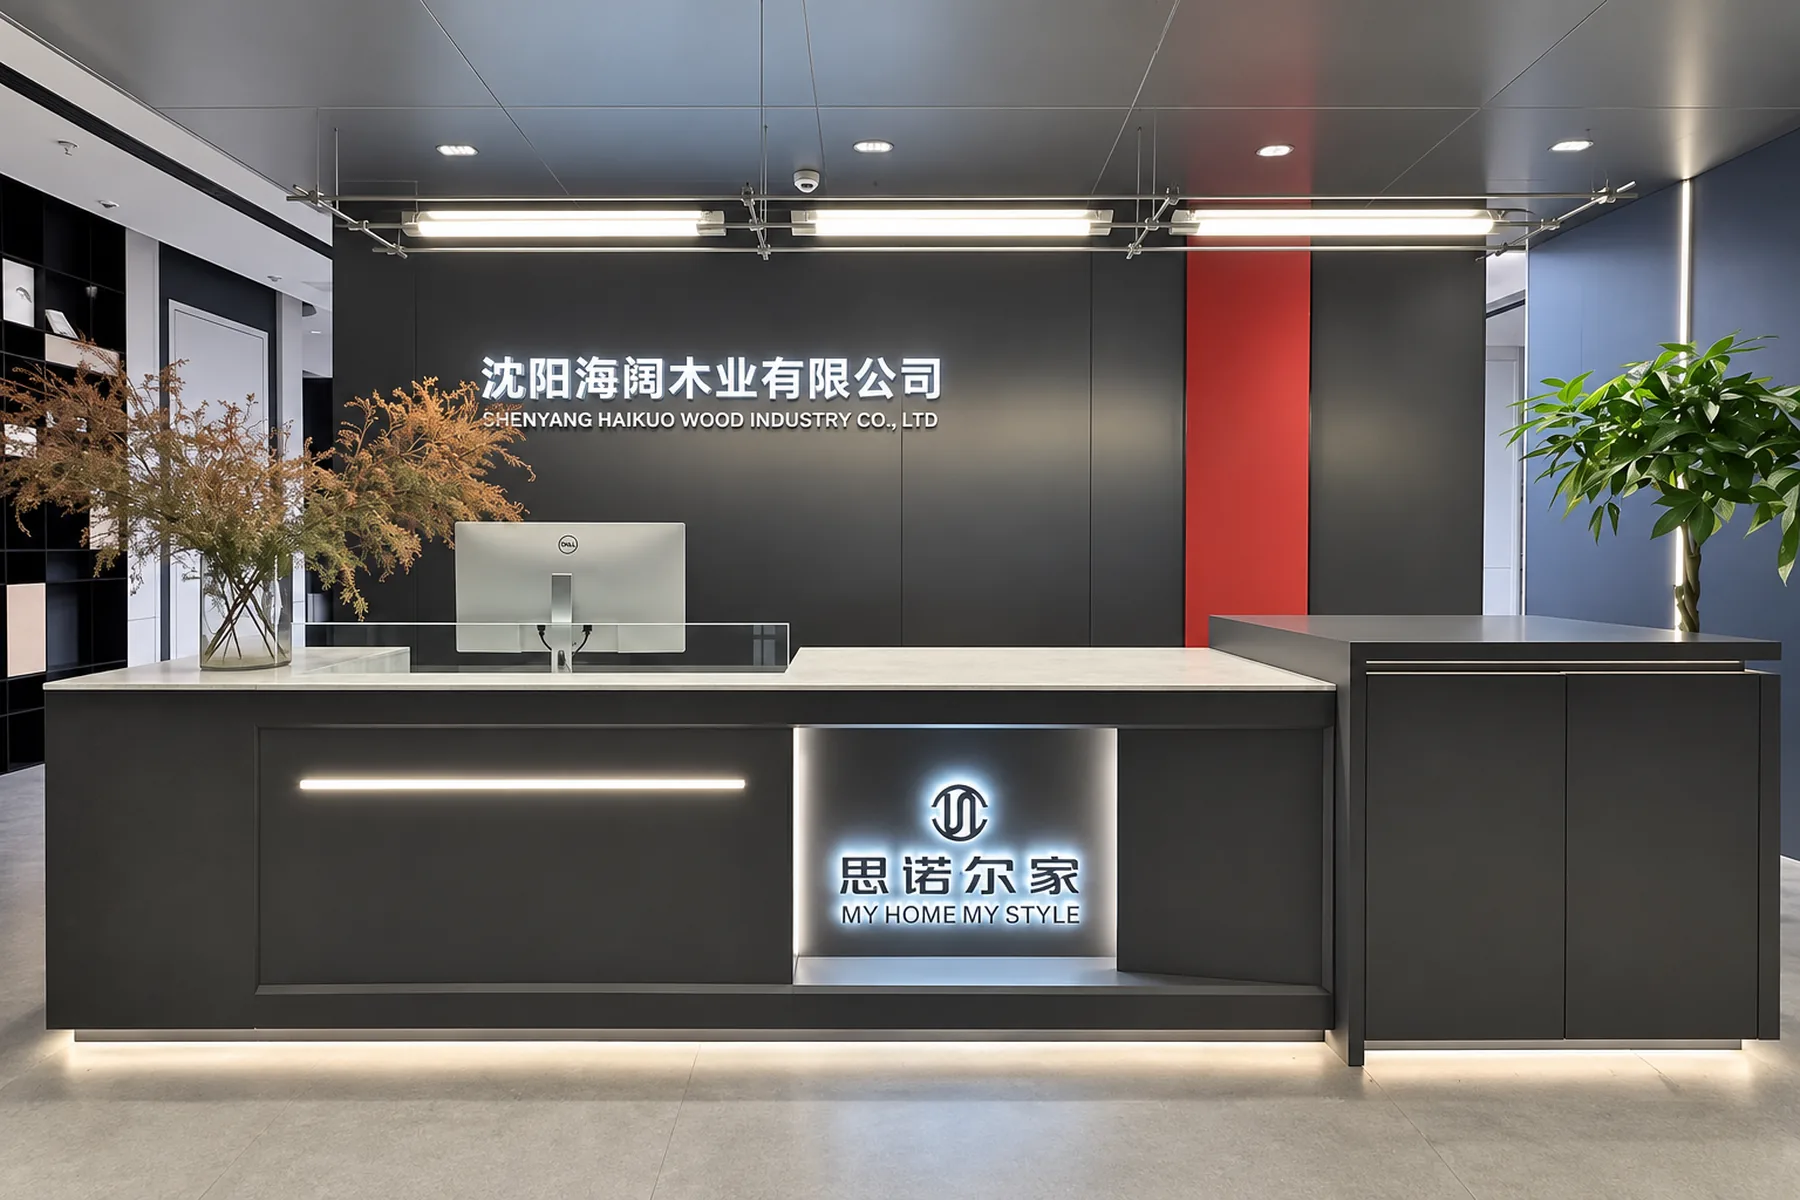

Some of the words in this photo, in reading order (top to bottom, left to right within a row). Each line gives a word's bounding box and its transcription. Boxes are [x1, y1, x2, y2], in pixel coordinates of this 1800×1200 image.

[481, 356, 942, 400] 沈阳海阔木业有限公司
[483, 411, 592, 428] SHENYANG
[599, 411, 675, 428] HAIKUO
[680, 411, 744, 428] WOOD
[750, 411, 852, 428] INDUSTRY
[856, 411, 897, 430] CO.,
[902, 411, 938, 428] LTD
[840, 856, 1080, 895] 思诺尔家
[842, 905, 879, 924] MY
[886, 905, 956, 924] HOME
[963, 905, 999, 924] MY
[1005, 905, 1080, 924] STYLE
